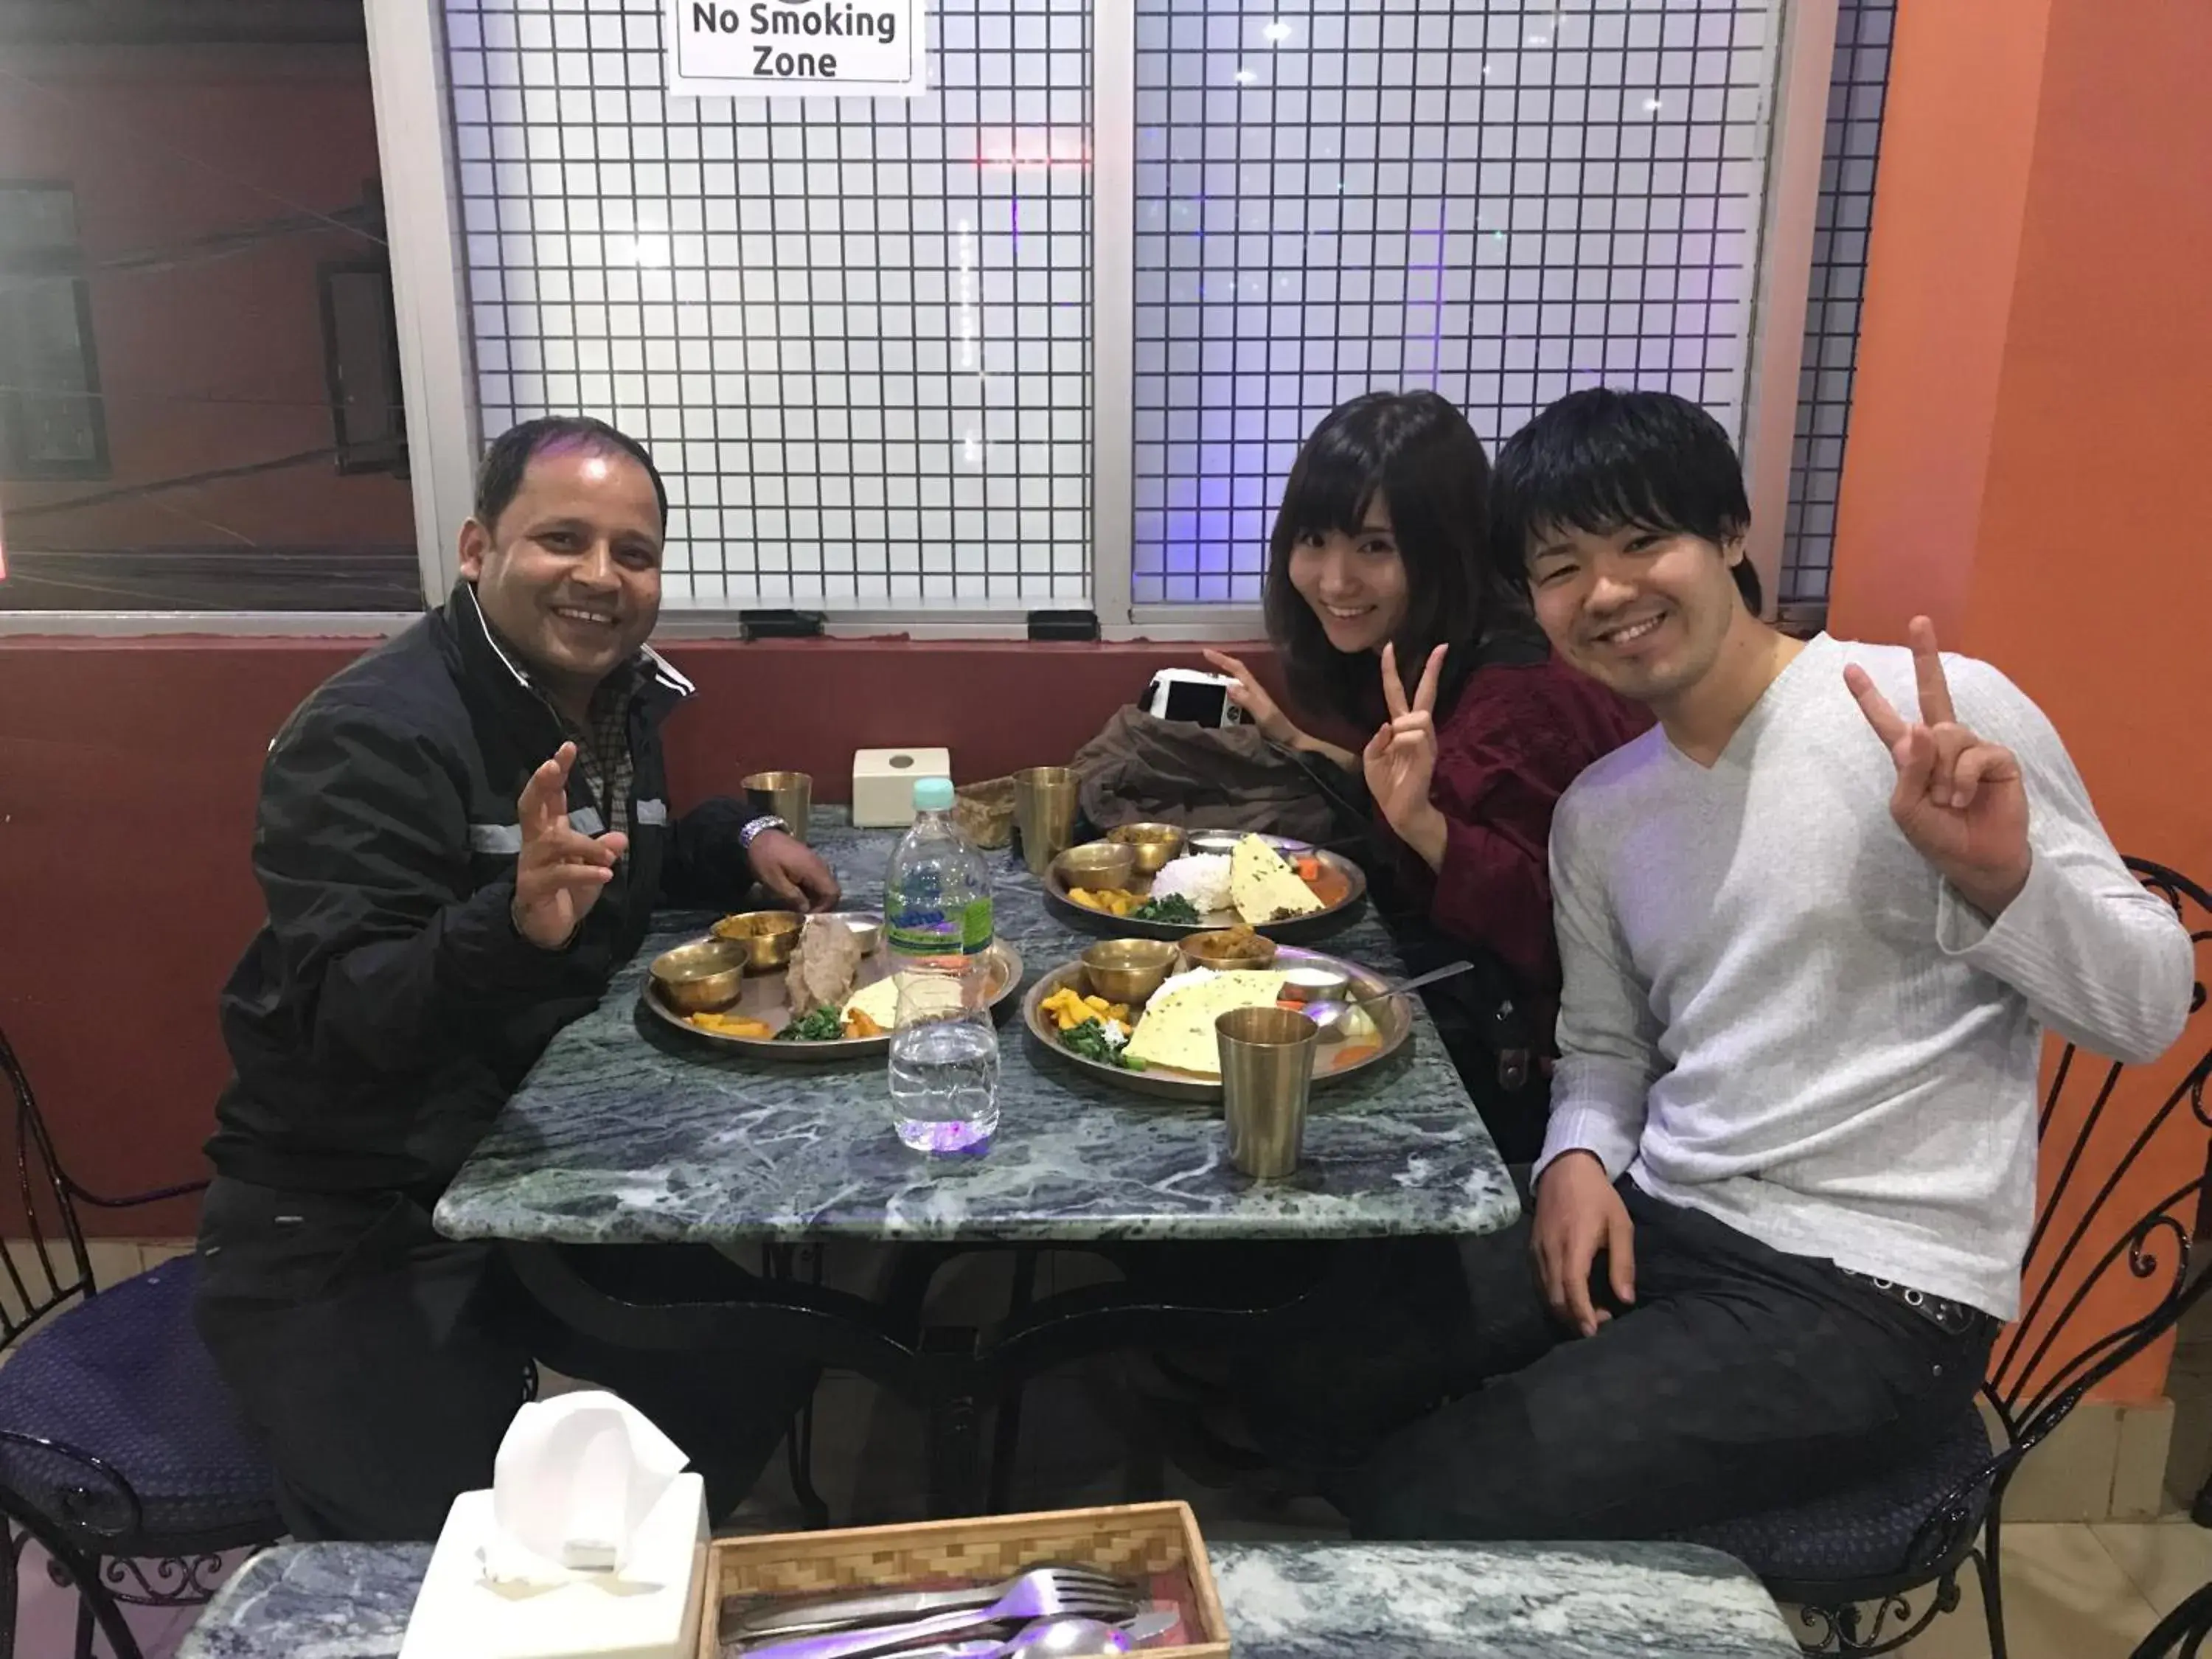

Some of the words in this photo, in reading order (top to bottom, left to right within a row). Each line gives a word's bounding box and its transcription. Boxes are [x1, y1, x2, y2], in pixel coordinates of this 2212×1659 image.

[693, 2, 739, 33] No
[751, 2, 895, 44] Smoking
[753, 46, 837, 77] Zone
